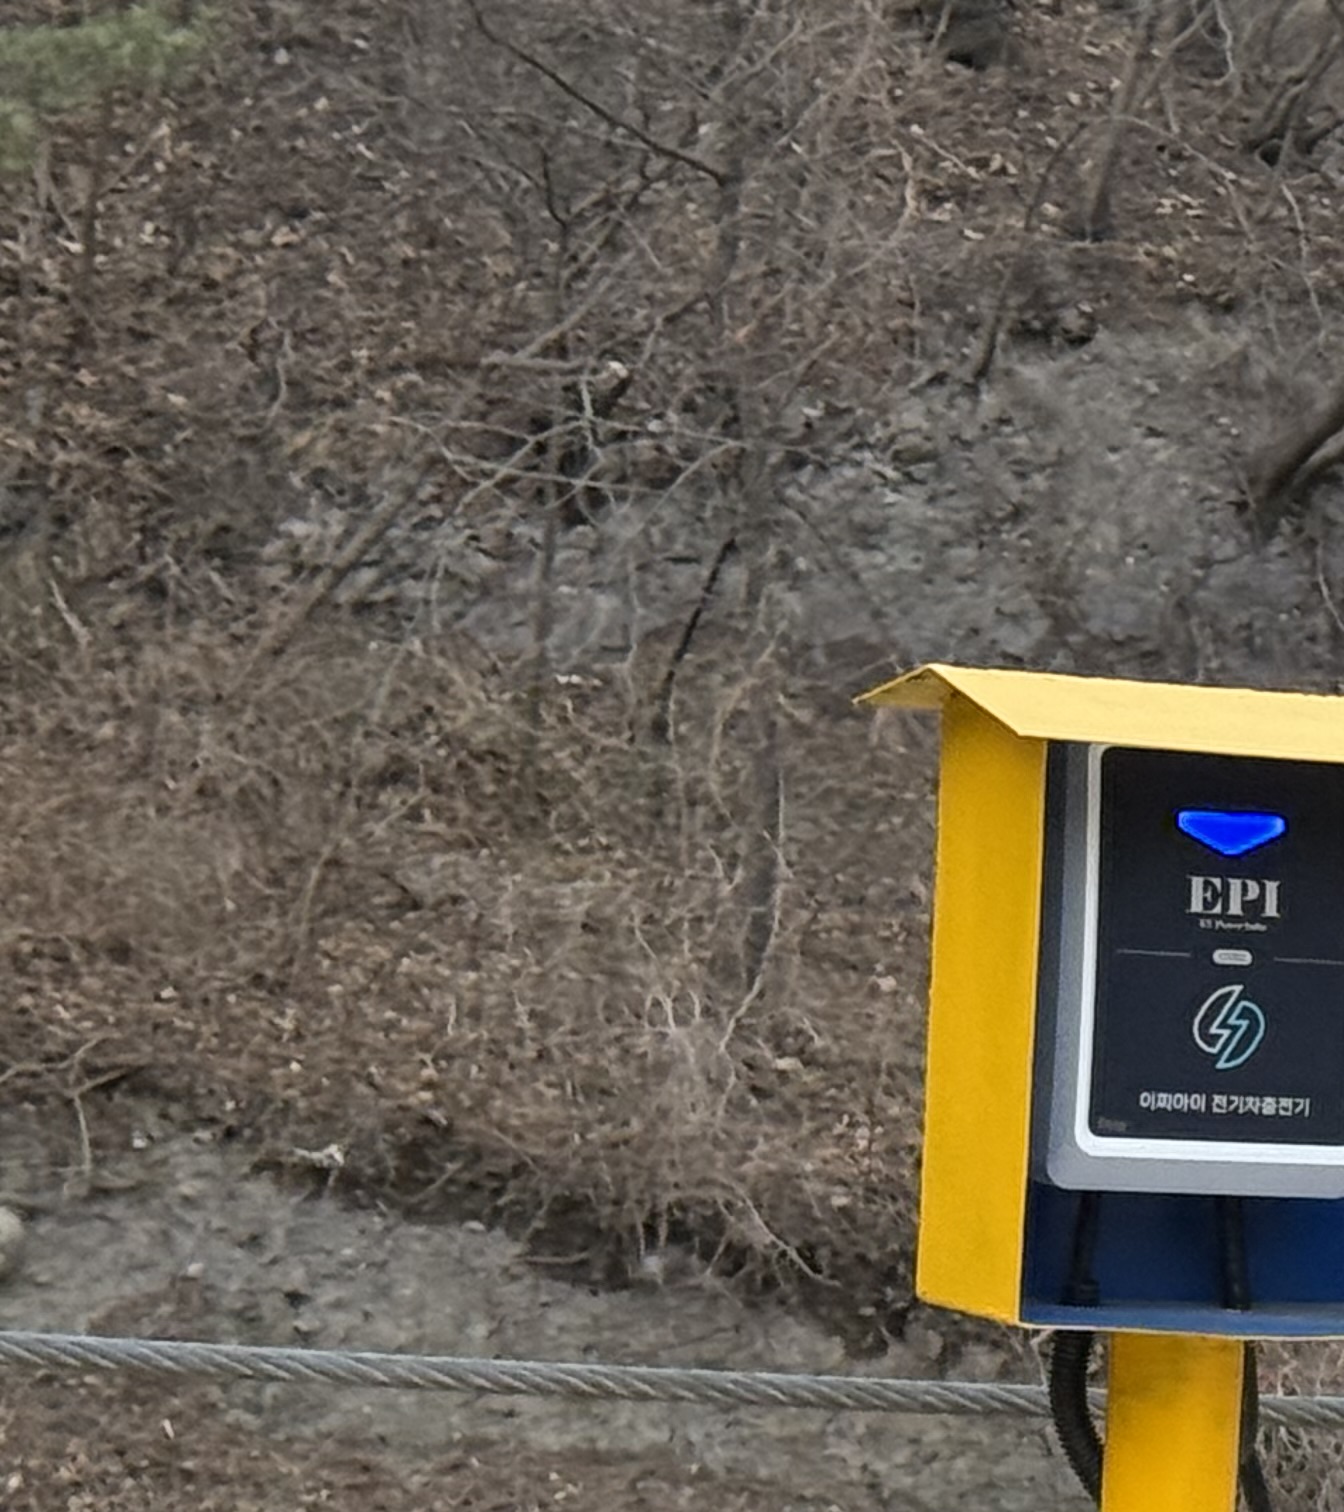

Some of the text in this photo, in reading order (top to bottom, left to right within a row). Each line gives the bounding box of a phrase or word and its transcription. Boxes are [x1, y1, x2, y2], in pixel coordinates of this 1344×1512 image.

[1185, 874, 1281, 918] EPI
[1139, 1091, 1310, 1117] 이피아이 전기차충전기
